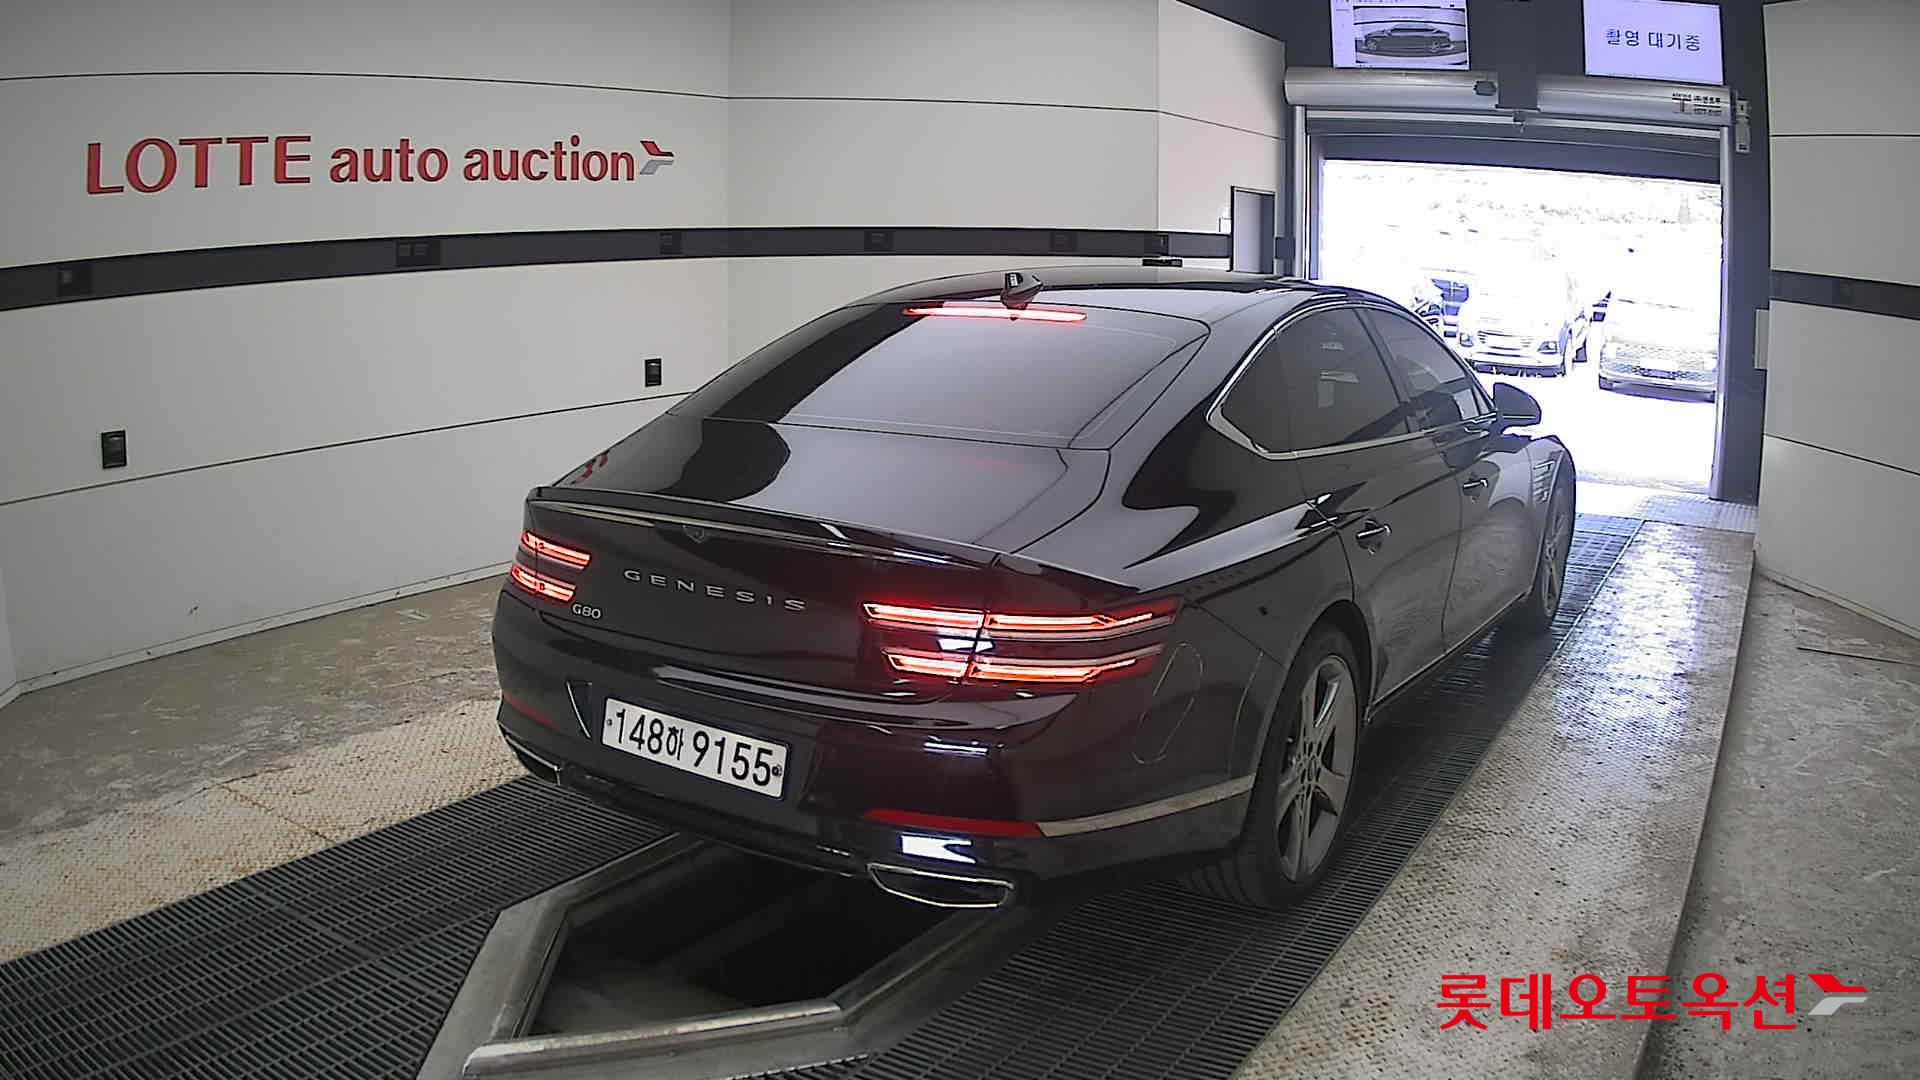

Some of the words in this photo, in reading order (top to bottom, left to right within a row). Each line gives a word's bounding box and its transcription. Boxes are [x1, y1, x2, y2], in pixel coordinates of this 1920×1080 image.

[1648, 32, 1701, 52] 대기중
[87, 135, 311, 195] LOTTE
[329, 138, 449, 182] auto
[463, 134, 635, 181] auction
[572, 603, 602, 619] G80
[623, 569, 805, 611] GENESIS
[616, 708, 684, 761] 148하
[693, 730, 773, 786] 9155
